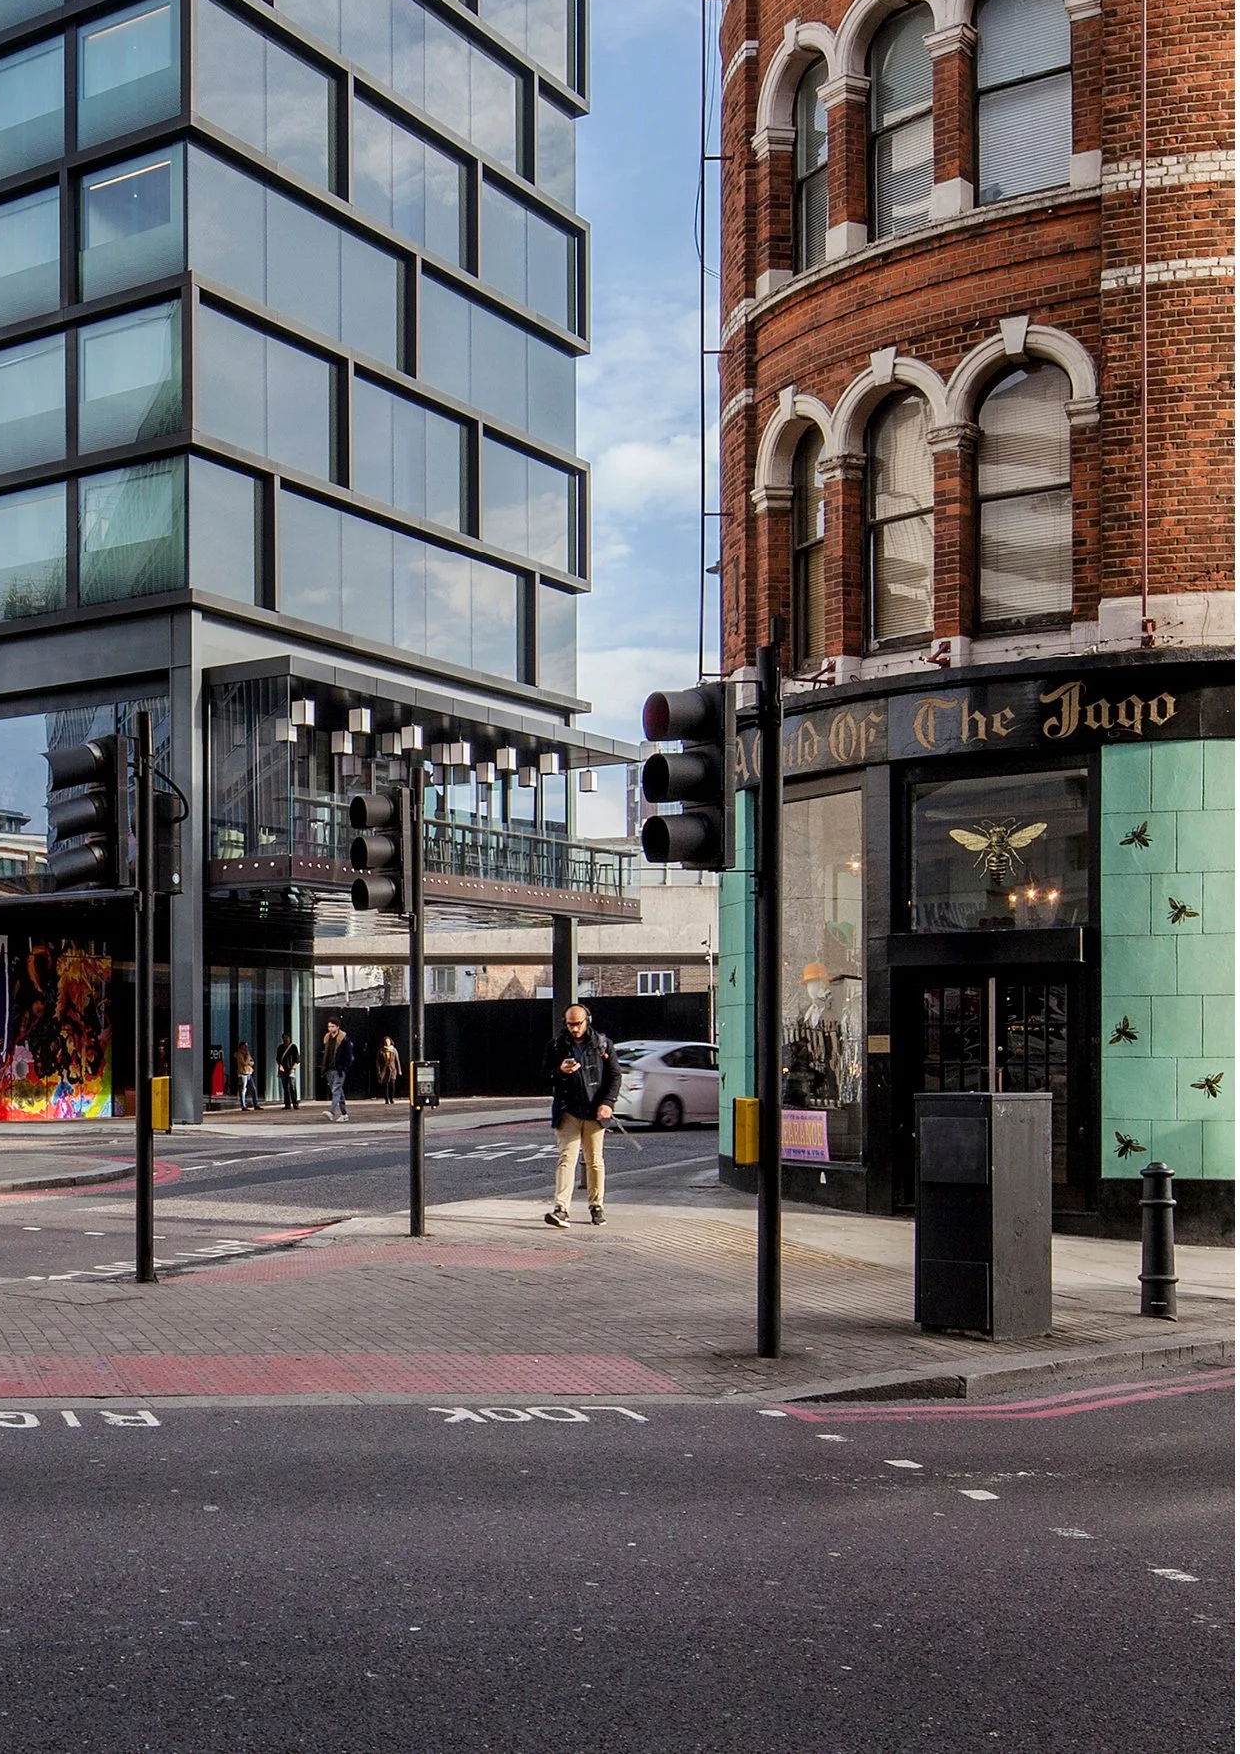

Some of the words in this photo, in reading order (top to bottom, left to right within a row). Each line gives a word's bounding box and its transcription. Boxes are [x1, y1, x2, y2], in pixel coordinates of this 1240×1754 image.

[752, 720, 820, 779] ild
[913, 696, 1023, 750] The
[1040, 680, 1179, 739] Jago
[428, 1406, 650, 1424] LOOK
